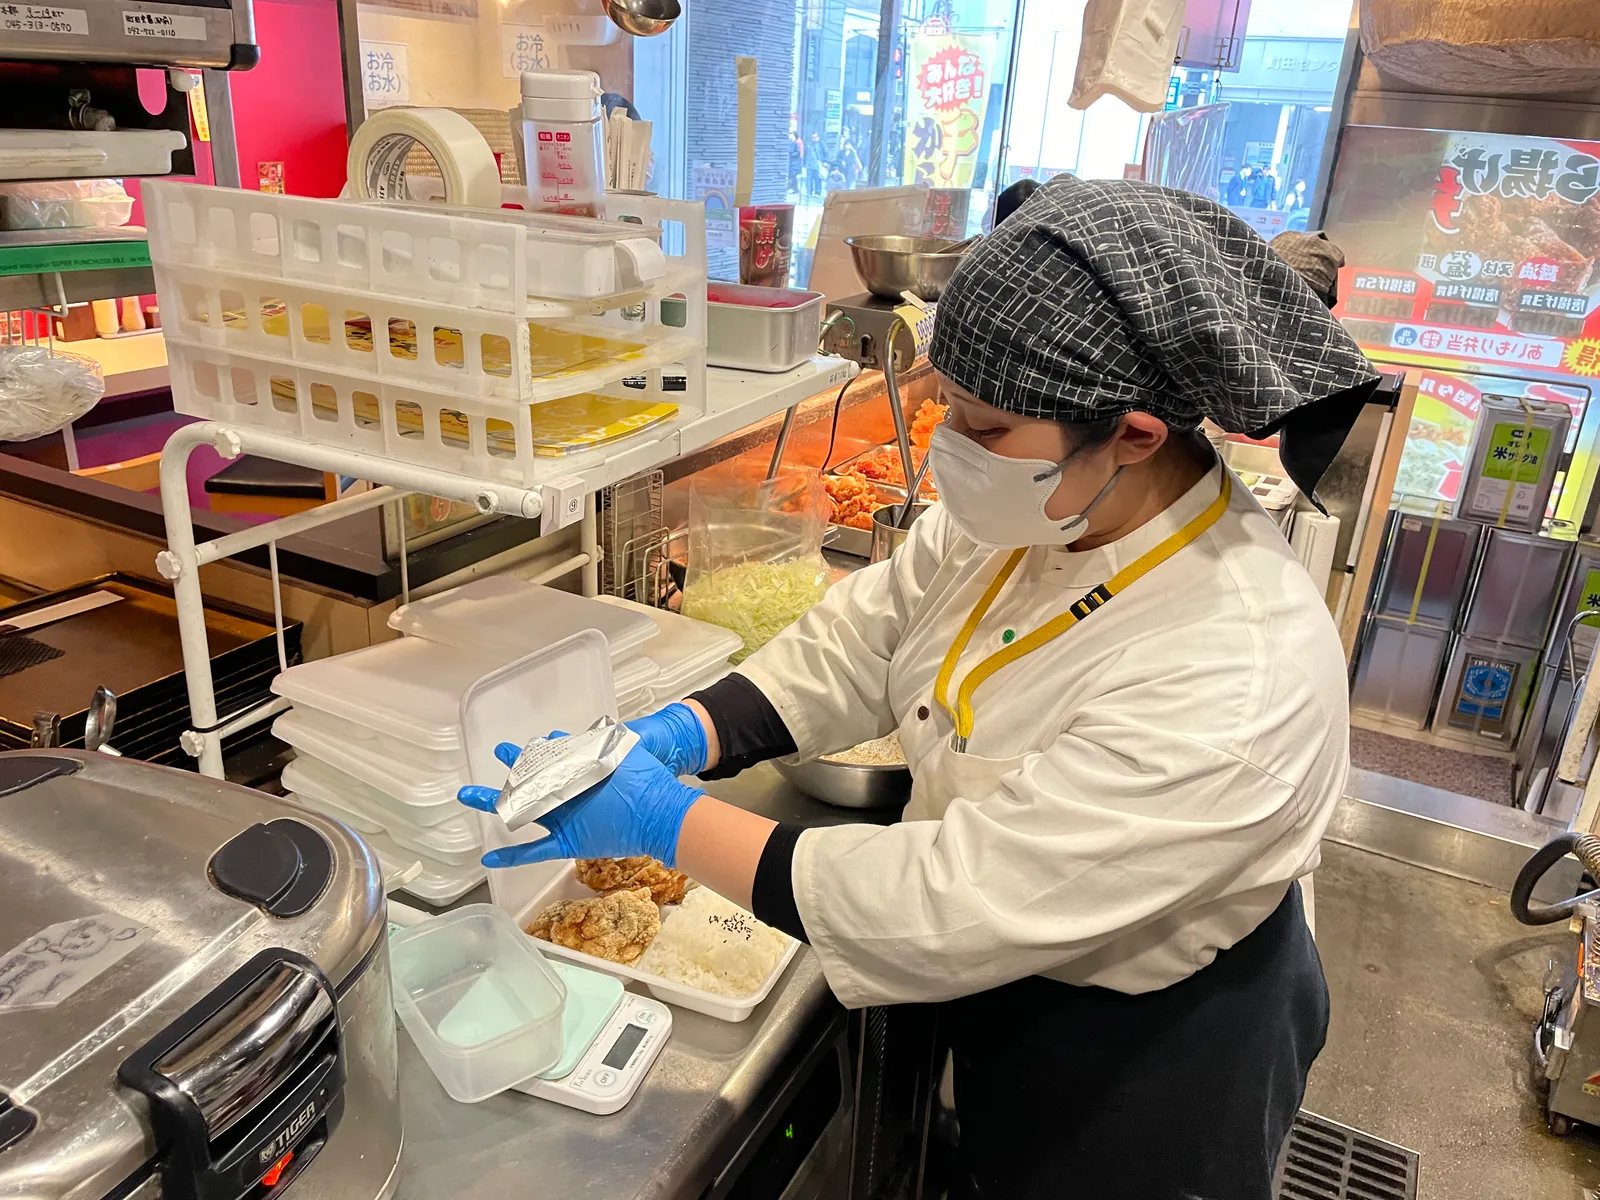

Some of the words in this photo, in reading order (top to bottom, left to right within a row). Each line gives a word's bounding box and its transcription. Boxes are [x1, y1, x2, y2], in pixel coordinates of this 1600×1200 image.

[516, 33, 544, 53] お冷
[367, 51, 394, 70] お冷
[926, 55, 978, 84] みんな
[600, 1072, 610, 1084] OFF
[275, 1101, 315, 1146] TIGER
